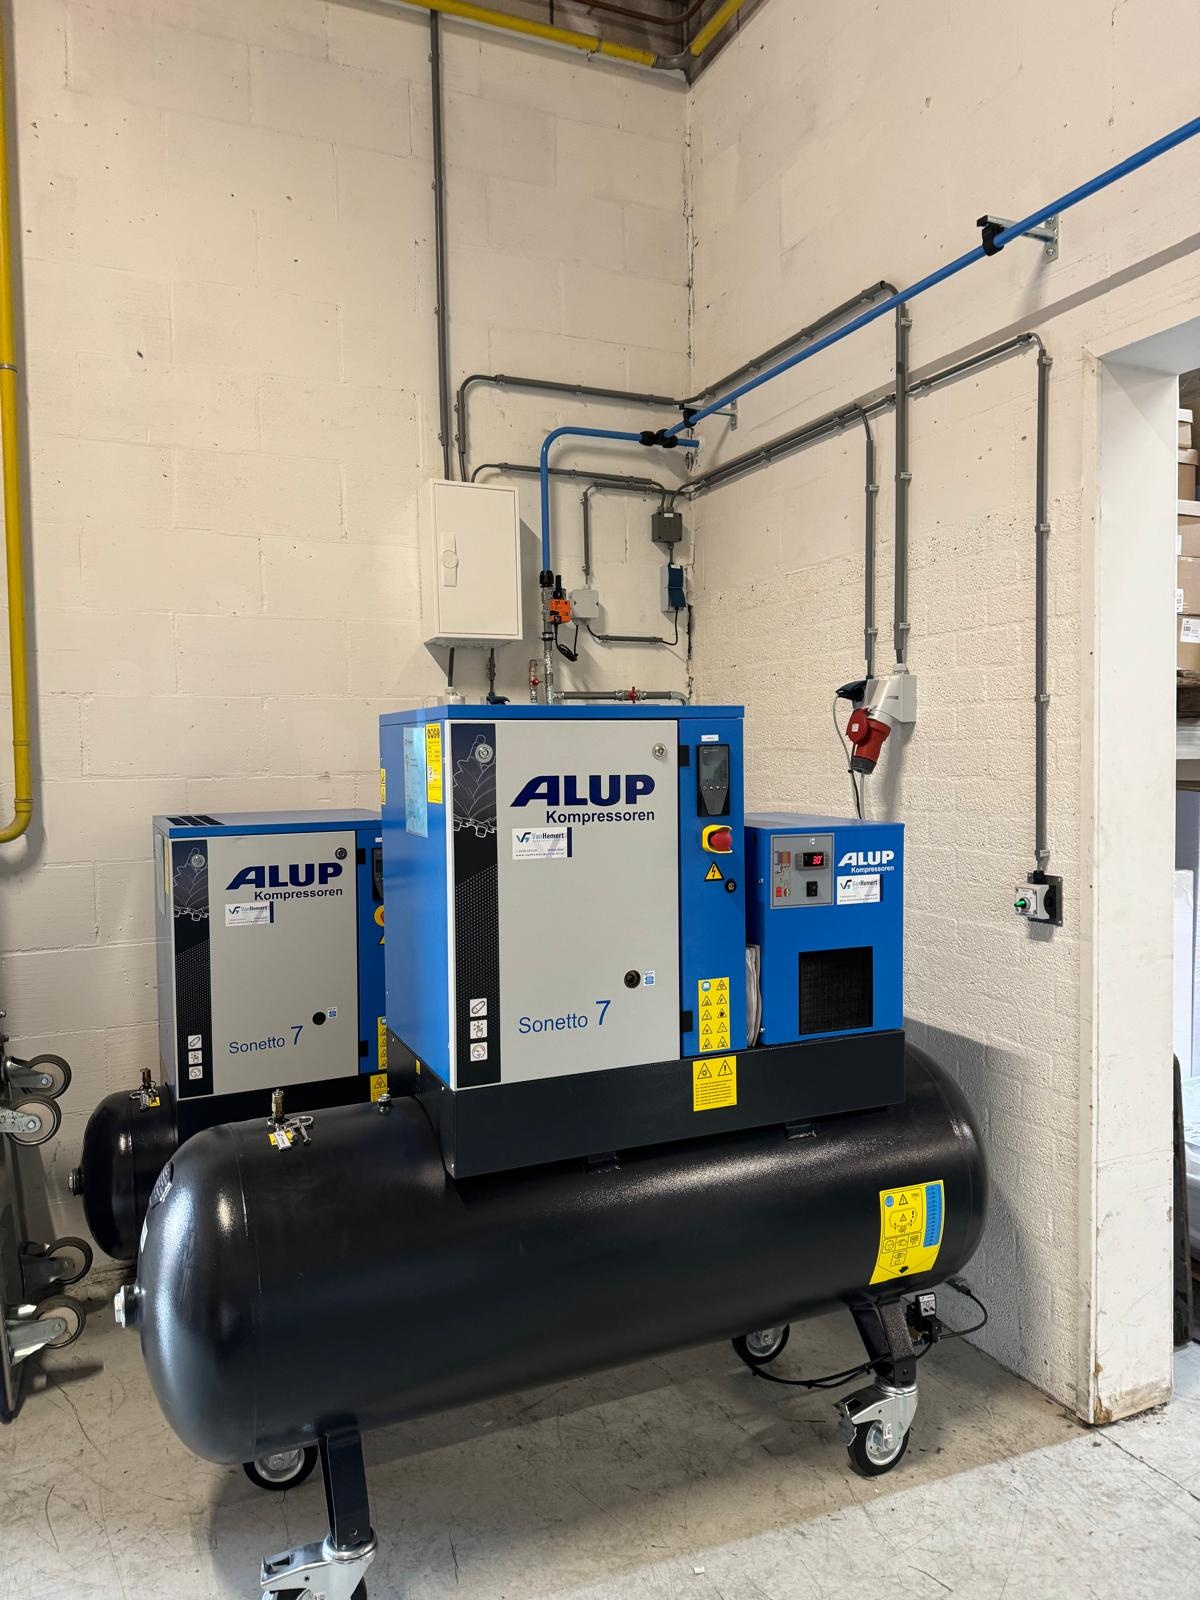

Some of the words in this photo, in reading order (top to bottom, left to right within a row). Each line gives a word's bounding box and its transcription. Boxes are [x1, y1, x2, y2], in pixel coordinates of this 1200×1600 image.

[510, 774, 656, 807] ALUP
[546, 810, 655, 826] Kompressoren
[532, 832, 564, 840] VanHemert
[838, 850, 895, 867] ALUP
[225, 862, 343, 890] ALUP
[851, 866, 895, 874] Kompressoren
[254, 888, 343, 901] Kompressoren
[518, 1013, 588, 1034] Sonetto
[595, 1000, 611, 1026] 7
[229, 1036, 285, 1054] Sonetto
[290, 1025, 303, 1046] 7
